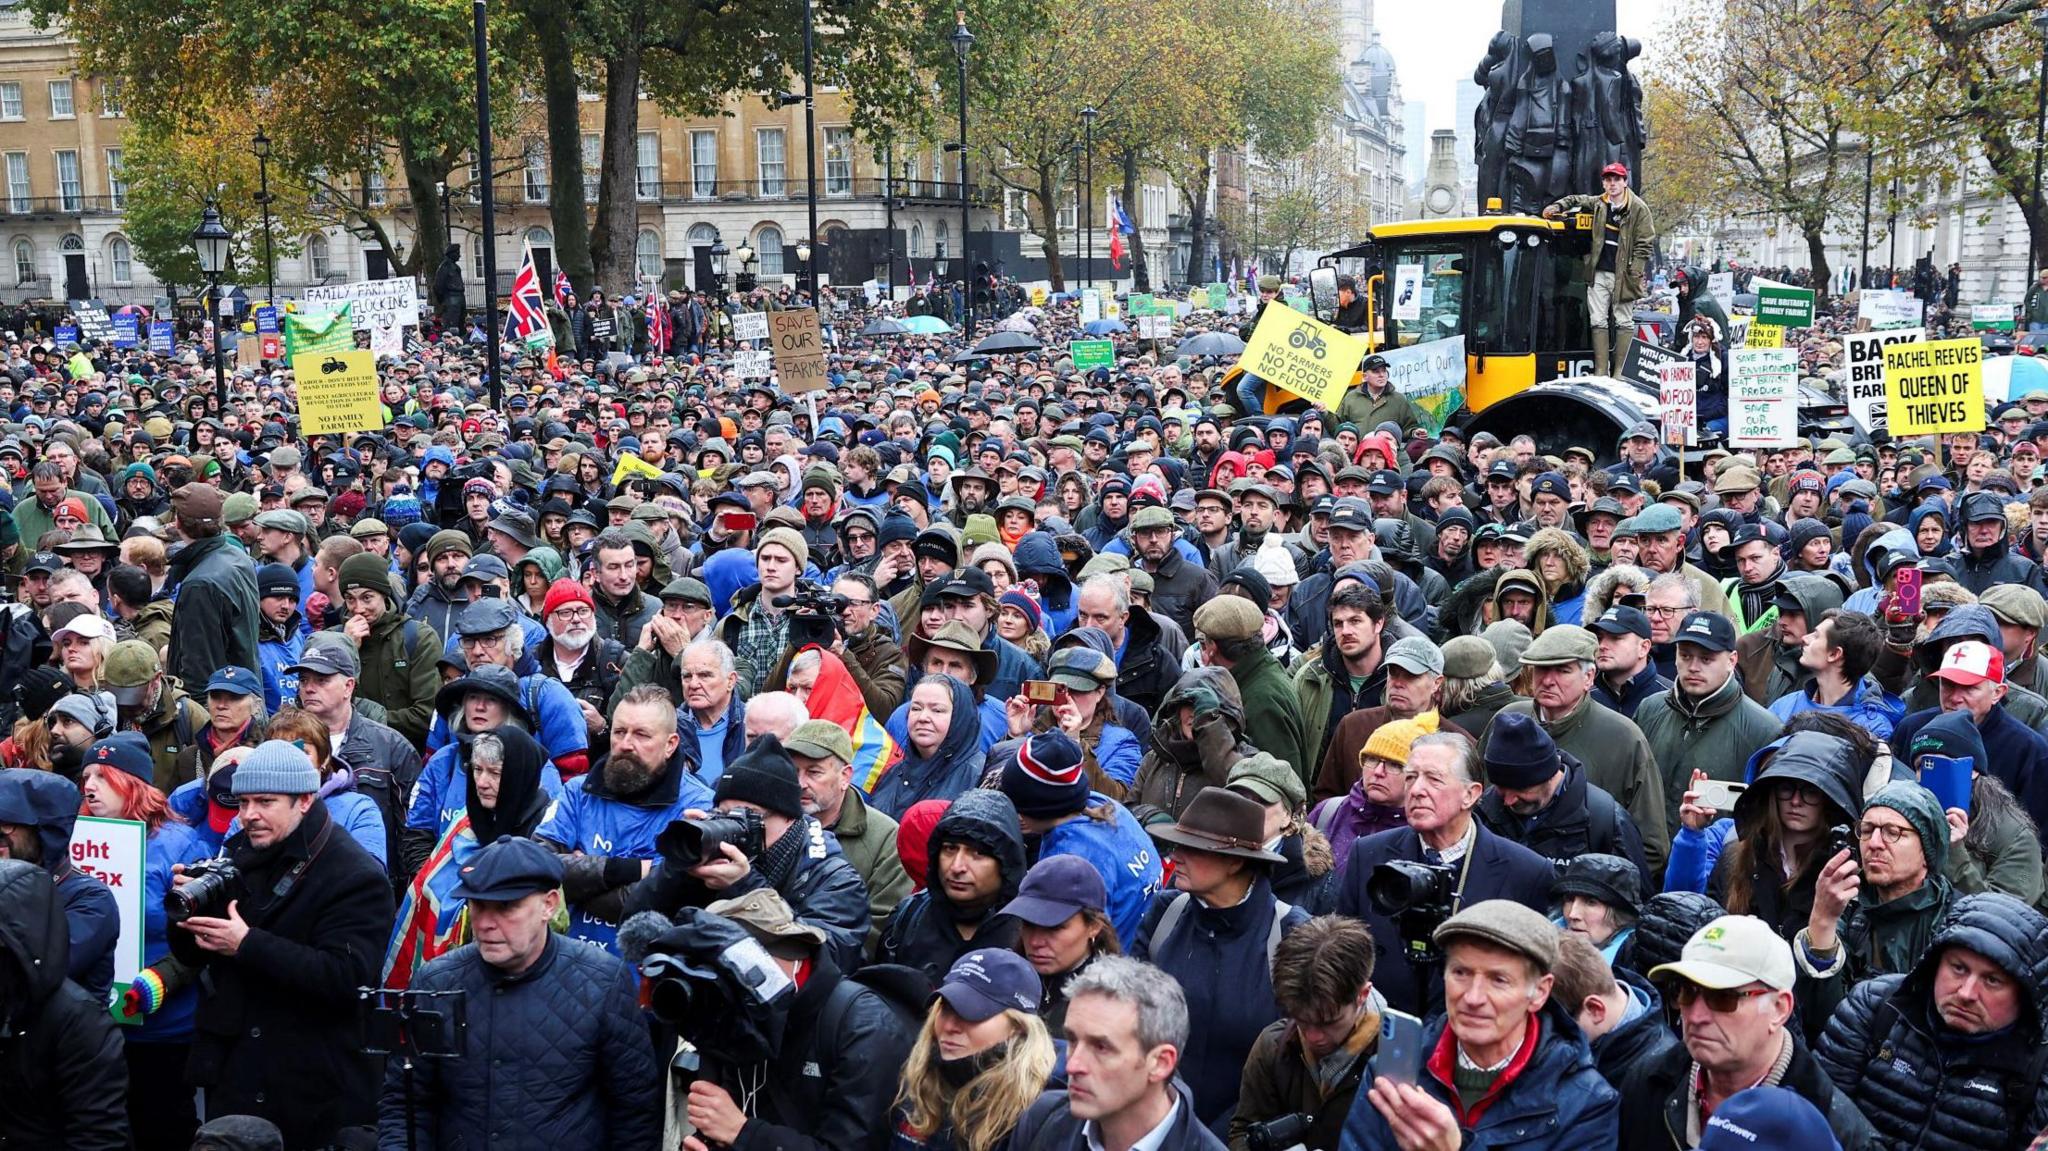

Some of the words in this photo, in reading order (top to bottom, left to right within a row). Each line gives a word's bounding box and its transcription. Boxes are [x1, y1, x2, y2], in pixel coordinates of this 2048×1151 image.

[307, 286, 351, 301] FAMILY
[357, 281, 386, 297] FARM
[391, 279, 413, 293] TAX
[352, 294, 409, 313] FLOCKING
[1761, 297, 1777, 306] SAVE
[1778, 298, 1810, 307] BRITAIN'S
[1762, 306, 1784, 315] FAMILY
[1785, 308, 1807, 316] FARMS
[734, 317, 743, 325] NO
[776, 315, 815, 332] SAVE
[781, 331, 814, 350] OUR
[1745, 338, 1774, 347] HIEVES
[1268, 342, 1285, 355] NO
[1286, 351, 1333, 378] FARMERS
[1638, 345, 1659, 360] WITH
[1736, 353, 1756, 362] SAVE
[1763, 353, 1783, 361] THE
[1888, 350, 1932, 370] RACHEL
[1935, 347, 1978, 366] REEVES
[783, 361, 825, 379] FARMS
[1262, 352, 1284, 368] NO
[1287, 364, 1328, 389] FOOD
[1392, 355, 1430, 383] upport
[1436, 355, 1454, 370] Our
[1660, 368, 1669, 382] NO
[1671, 367, 1693, 382] FARMERS
[1258, 363, 1277, 377] NO
[1278, 373, 1323, 400] FUTURE
[1731, 376, 1751, 387] EAT
[1757, 375, 1789, 385] BRITISH
[1900, 375, 1947, 400] QUEEN
[1952, 373, 1969, 394] OF
[331, 391, 375, 399] AGRICULTURAL
[1660, 389, 1671, 405] NO
[1673, 388, 1695, 405] FOOD
[1741, 386, 1783, 396] PRODUCE
[306, 398, 345, 406] REVOLUTION
[1744, 403, 1770, 413] SAVE
[318, 415, 331, 424] NO
[332, 413, 364, 422] FAMILY
[1661, 411, 1669, 424] NO
[1669, 409, 1694, 426] FUTURE
[1746, 414, 1768, 425] OUR
[1907, 401, 1967, 425] THIEVES
[320, 422, 345, 431] FARM
[347, 421, 364, 429] TAX
[1740, 425, 1778, 436] FARMS
[593, 832, 613, 852] No
[71, 840, 110, 862] ght
[1128, 849, 1150, 878] NO
